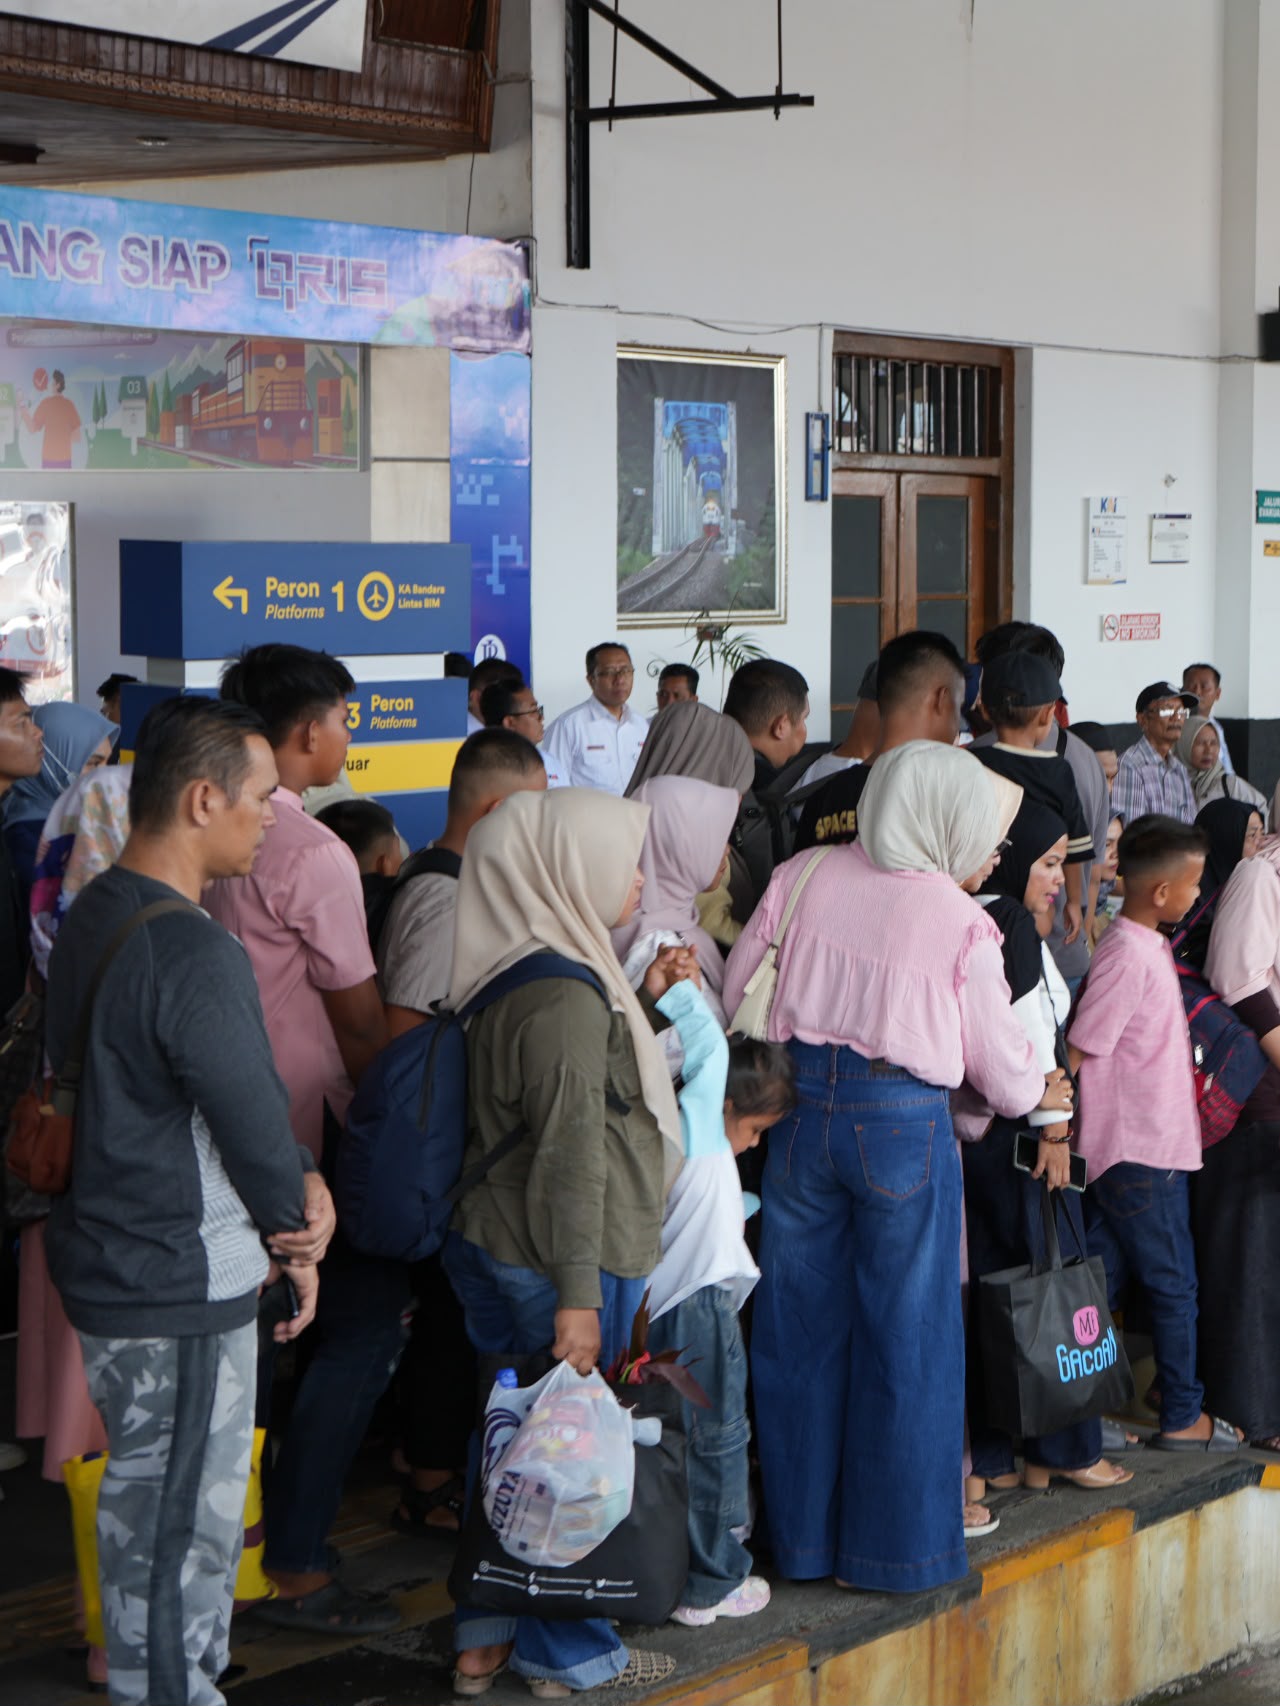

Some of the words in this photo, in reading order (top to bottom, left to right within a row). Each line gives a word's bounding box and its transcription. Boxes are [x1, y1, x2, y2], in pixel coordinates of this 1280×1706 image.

[119, 235, 229, 291] SIAP
[254, 249, 387, 311] QRIS
[127, 380, 141, 395] 03
[1263, 496, 1280, 507] JALUR
[265, 576, 320, 598] Peron
[398, 584, 411, 594] KA
[331, 581, 344, 612] 1
[398, 597, 423, 609] Lintas
[265, 603, 325, 620] Platforms
[1120, 629, 1130, 640] NO
[370, 693, 414, 712] Peron
[370, 715, 417, 730] Platforms
[346, 758, 370, 772] uar
[815, 810, 856, 840] SPACE
[1056, 1326, 1117, 1383] GACOAN
[490, 1470, 521, 1530] UZUYA
